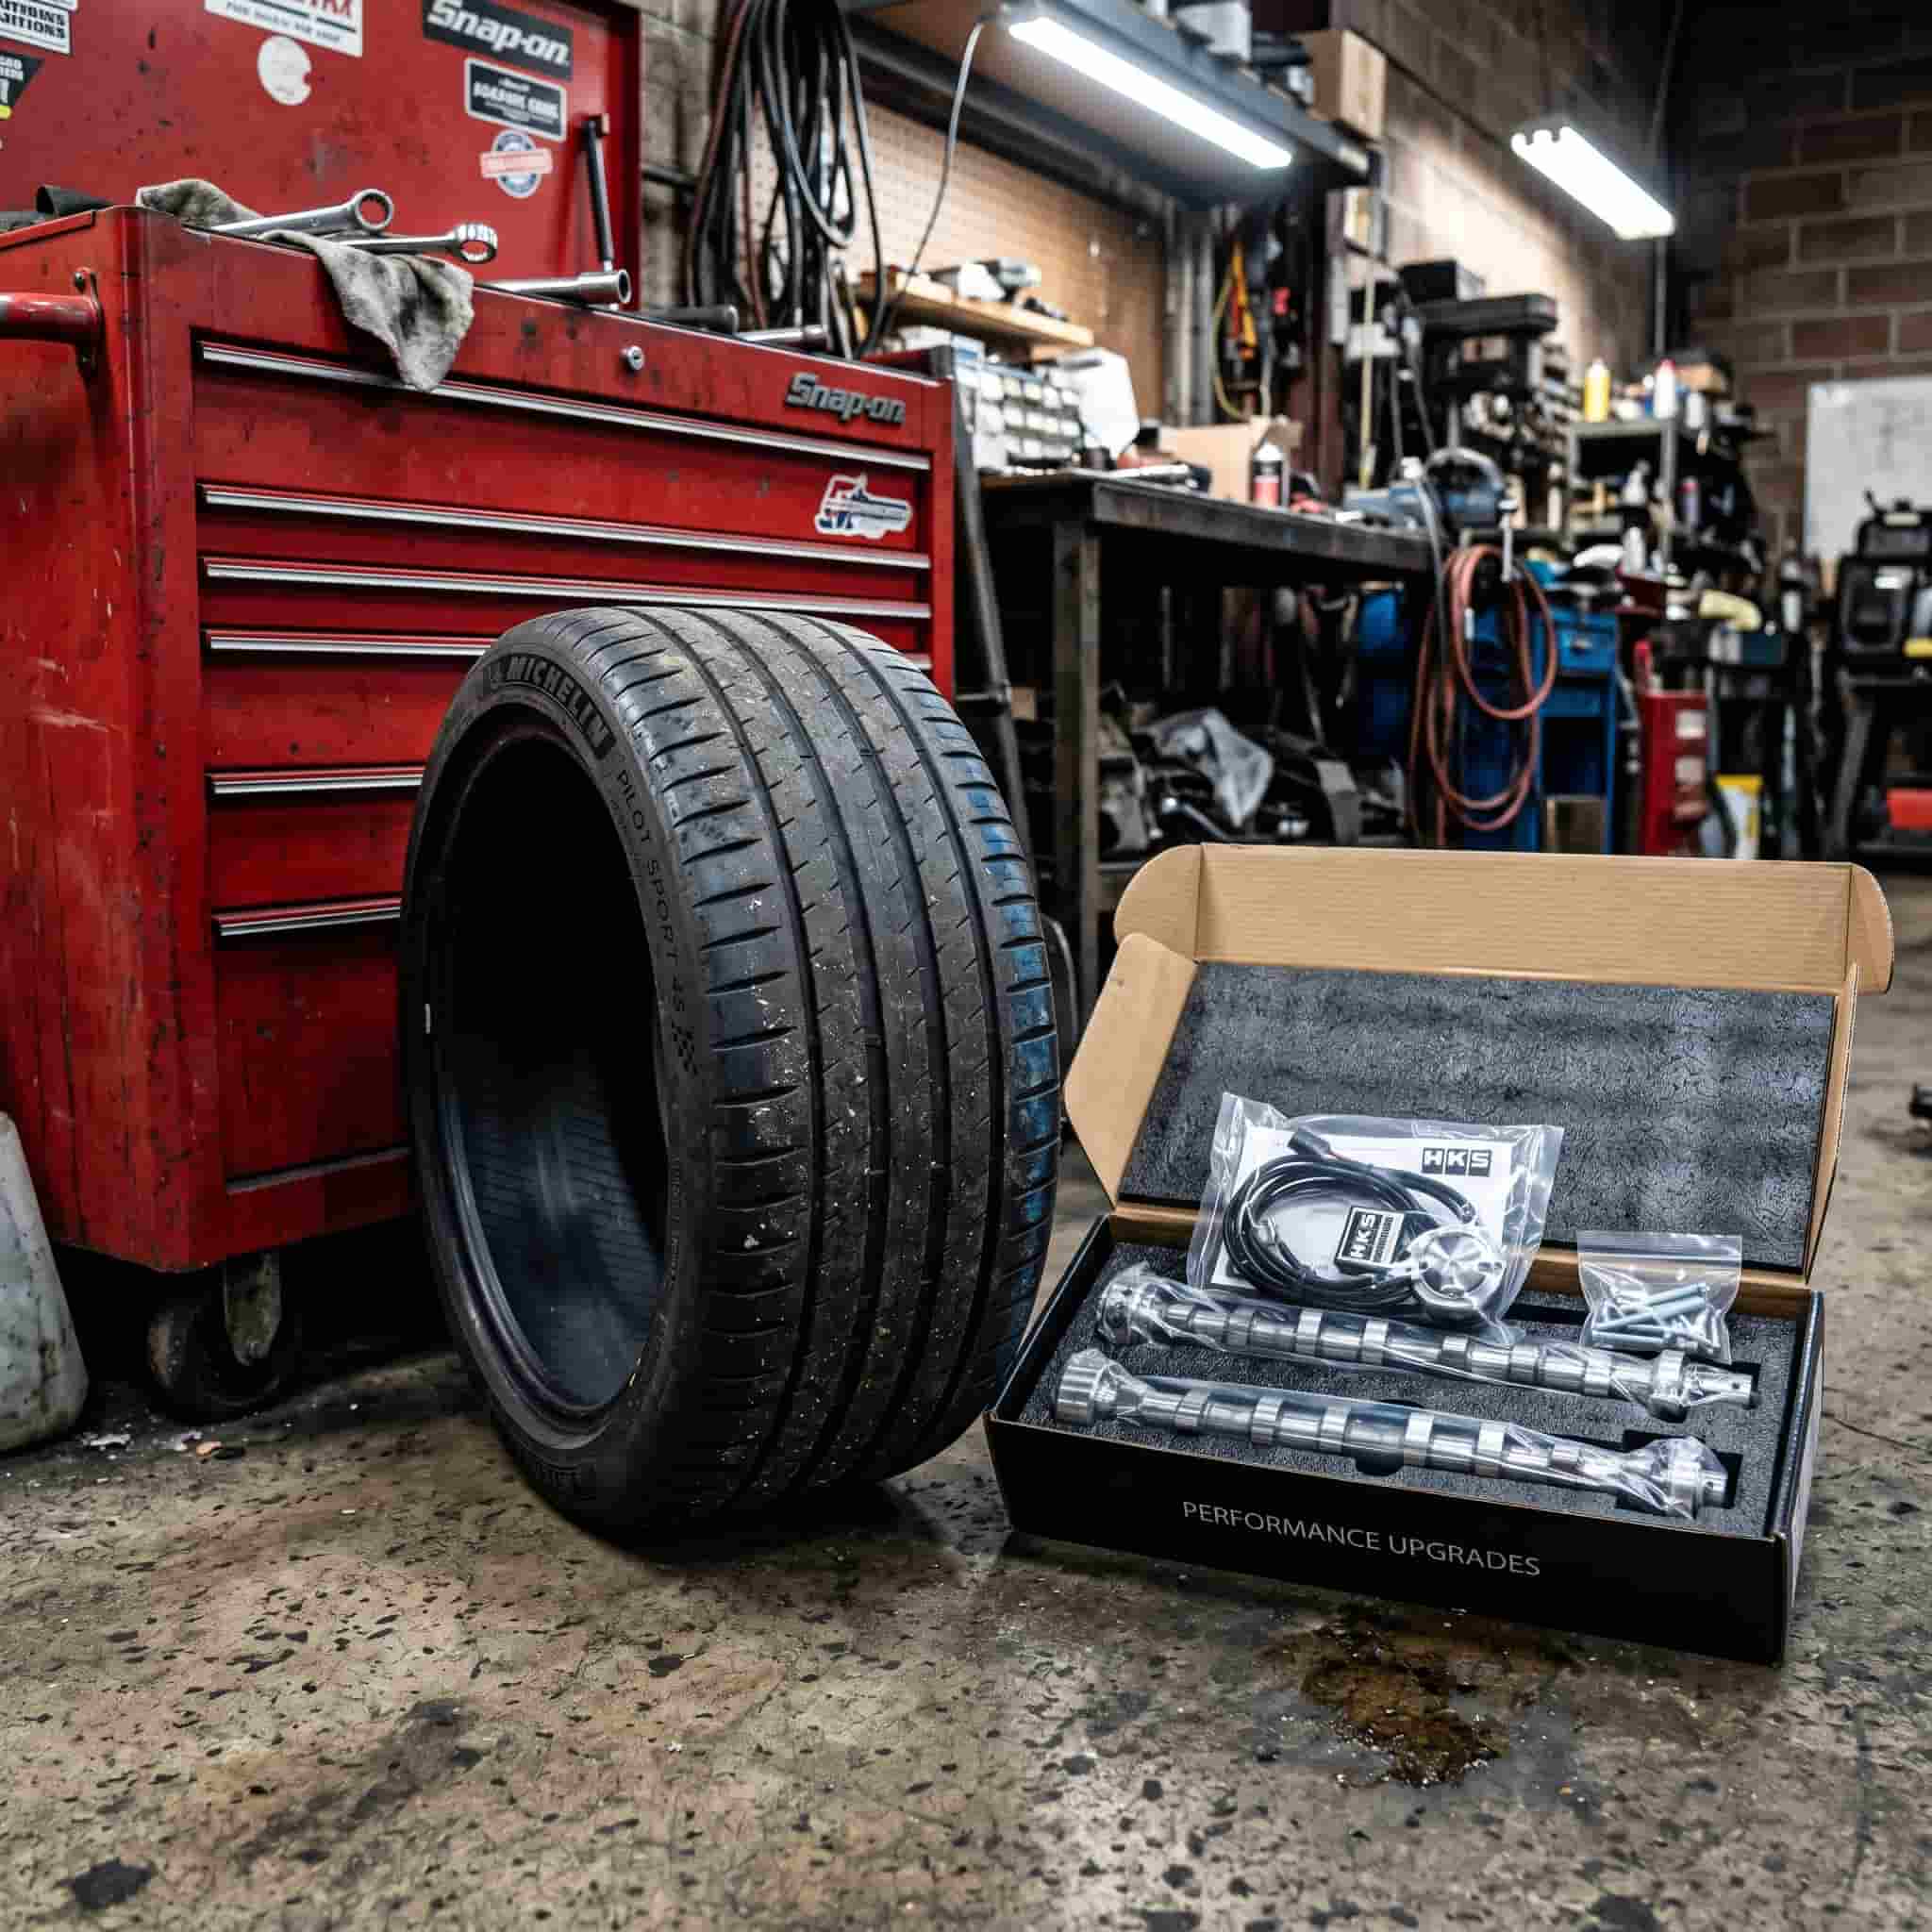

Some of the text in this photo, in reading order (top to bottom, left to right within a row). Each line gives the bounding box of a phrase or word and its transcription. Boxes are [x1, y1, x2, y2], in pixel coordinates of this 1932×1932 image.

[427, 0, 569, 65] Snap-on
[786, 373, 906, 425] Snap-on
[506, 656, 609, 745] MICHELIN
[617, 769, 650, 842] PILOT
[648, 859, 679, 959] SPORT
[1424, 1150, 1491, 1172] HKS
[1349, 1213, 1376, 1258] HKS
[1182, 1501, 1541, 1577] PERFORMANCE UPGRADES
